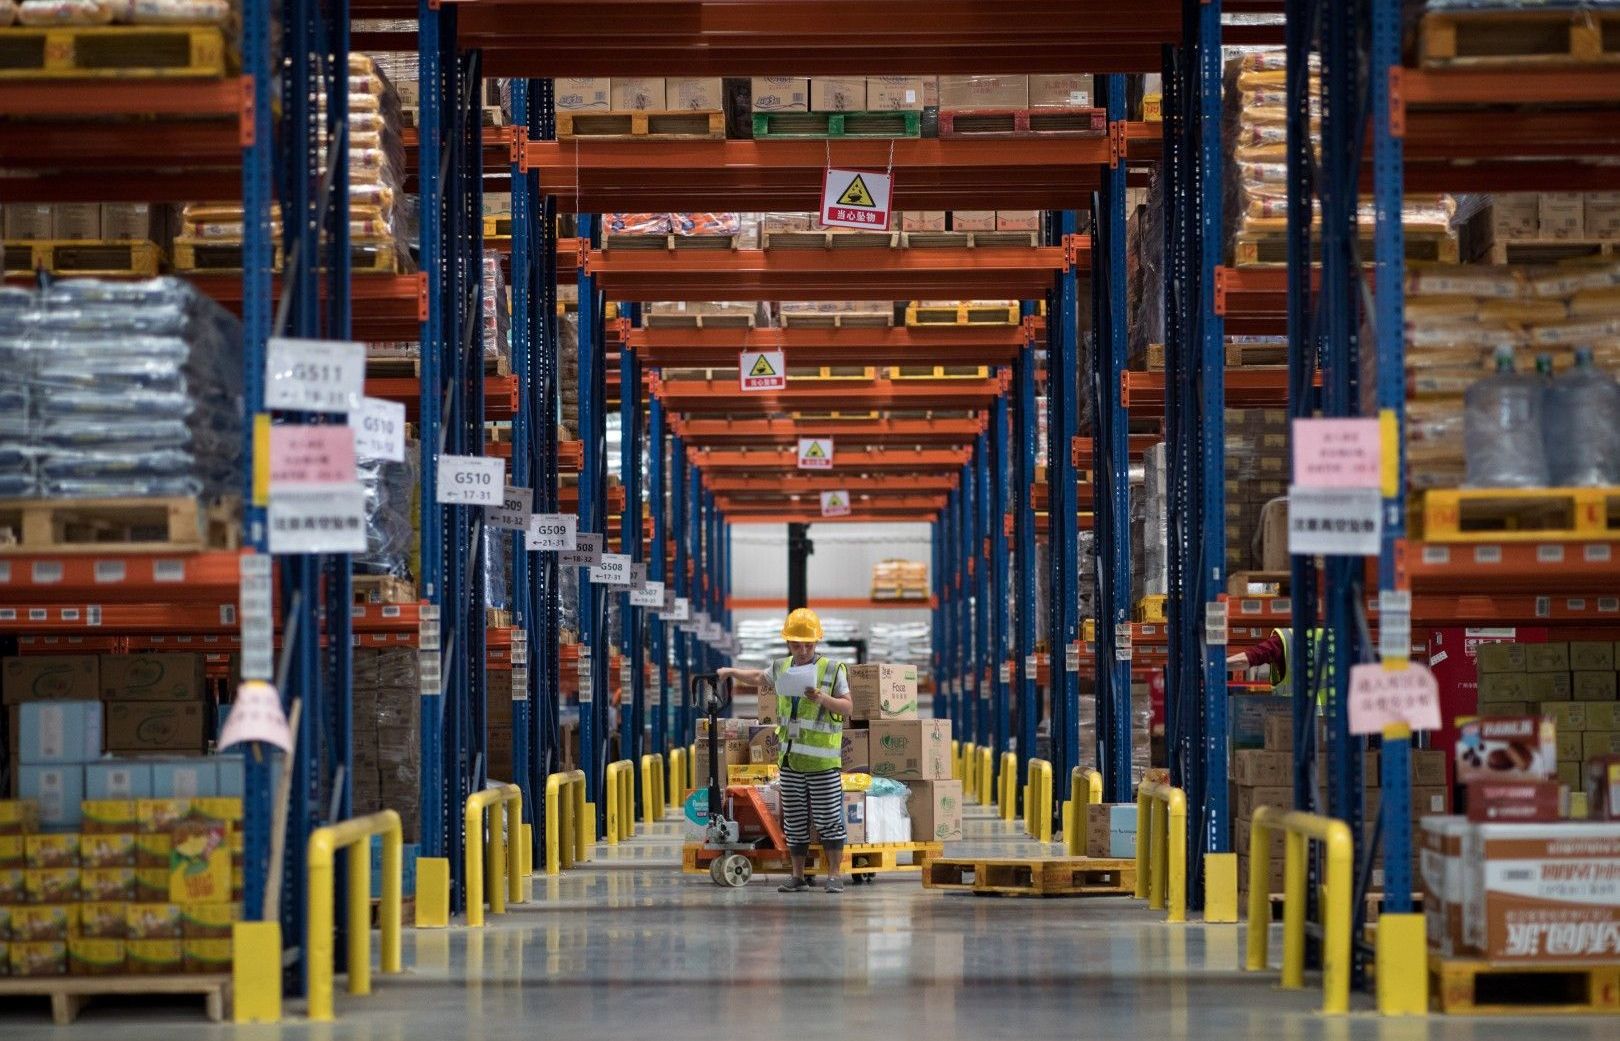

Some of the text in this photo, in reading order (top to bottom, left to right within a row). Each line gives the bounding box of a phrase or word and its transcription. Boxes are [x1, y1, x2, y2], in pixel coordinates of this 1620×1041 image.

[837, 209, 876, 222] 当心坠物
[294, 364, 342, 381] G511
[364, 416, 395, 434] G510
[455, 472, 491, 484] G510
[463, 490, 491, 500] 17-31
[497, 500, 522, 511] 509
[502, 516, 523, 525] 18-32
[539, 525, 566, 535] G509
[601, 563, 623, 571] G508
